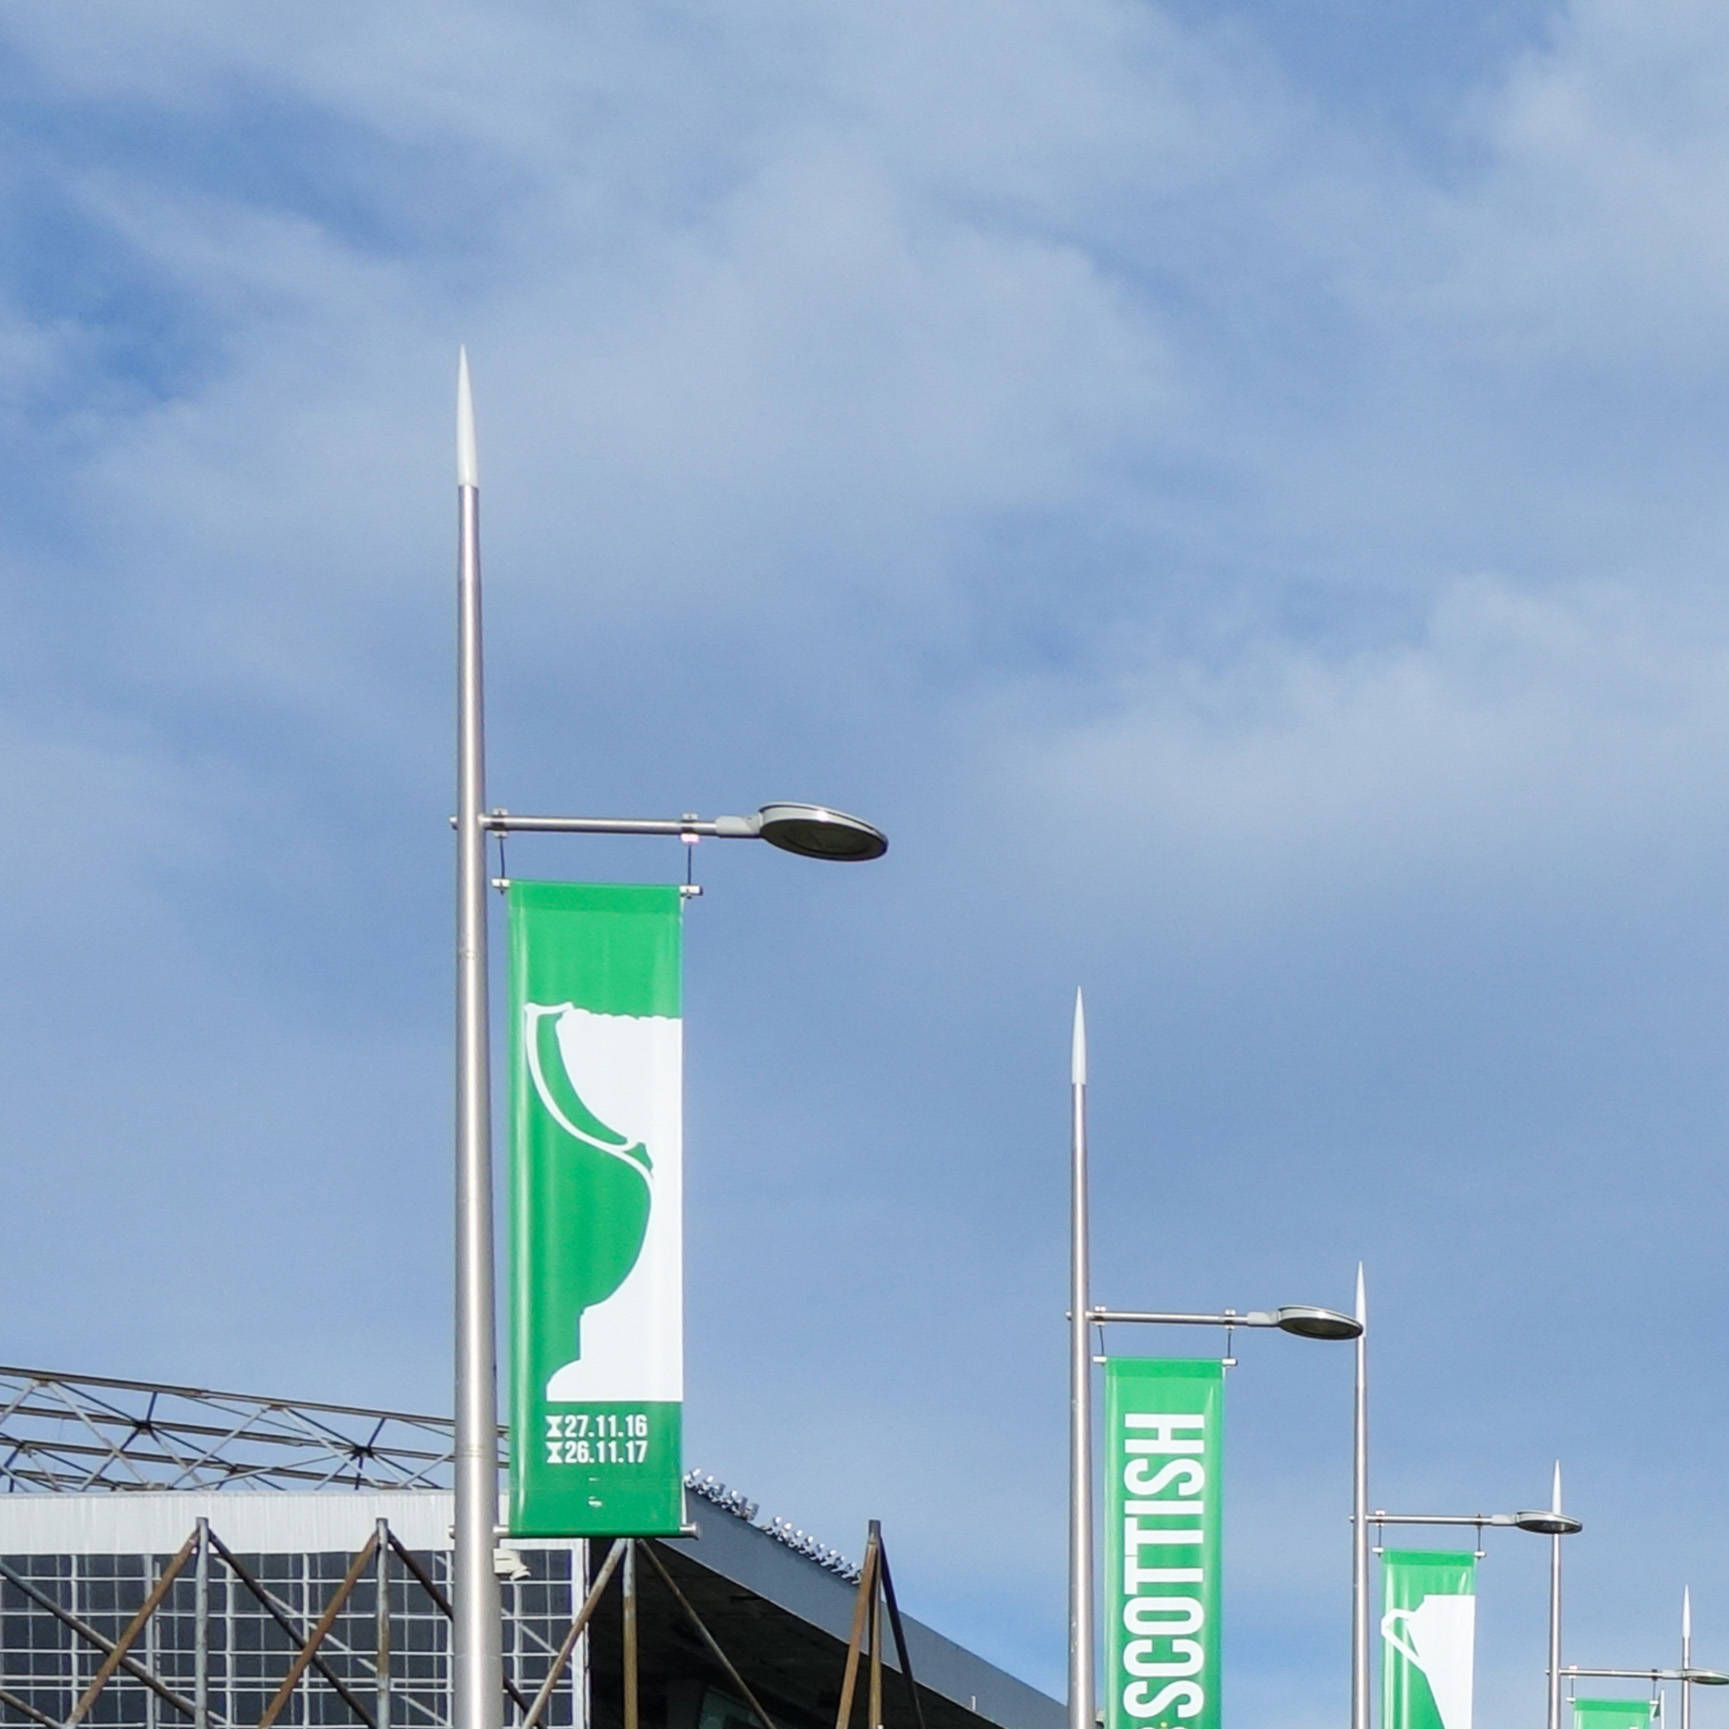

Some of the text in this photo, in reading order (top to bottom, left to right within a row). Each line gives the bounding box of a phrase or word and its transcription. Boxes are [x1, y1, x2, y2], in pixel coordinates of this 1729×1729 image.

[565, 1414, 648, 1439] 27.11.16
[565, 1440, 648, 1464] 26.11.17
[1123, 1413, 1205, 1718] SCOTTISH
